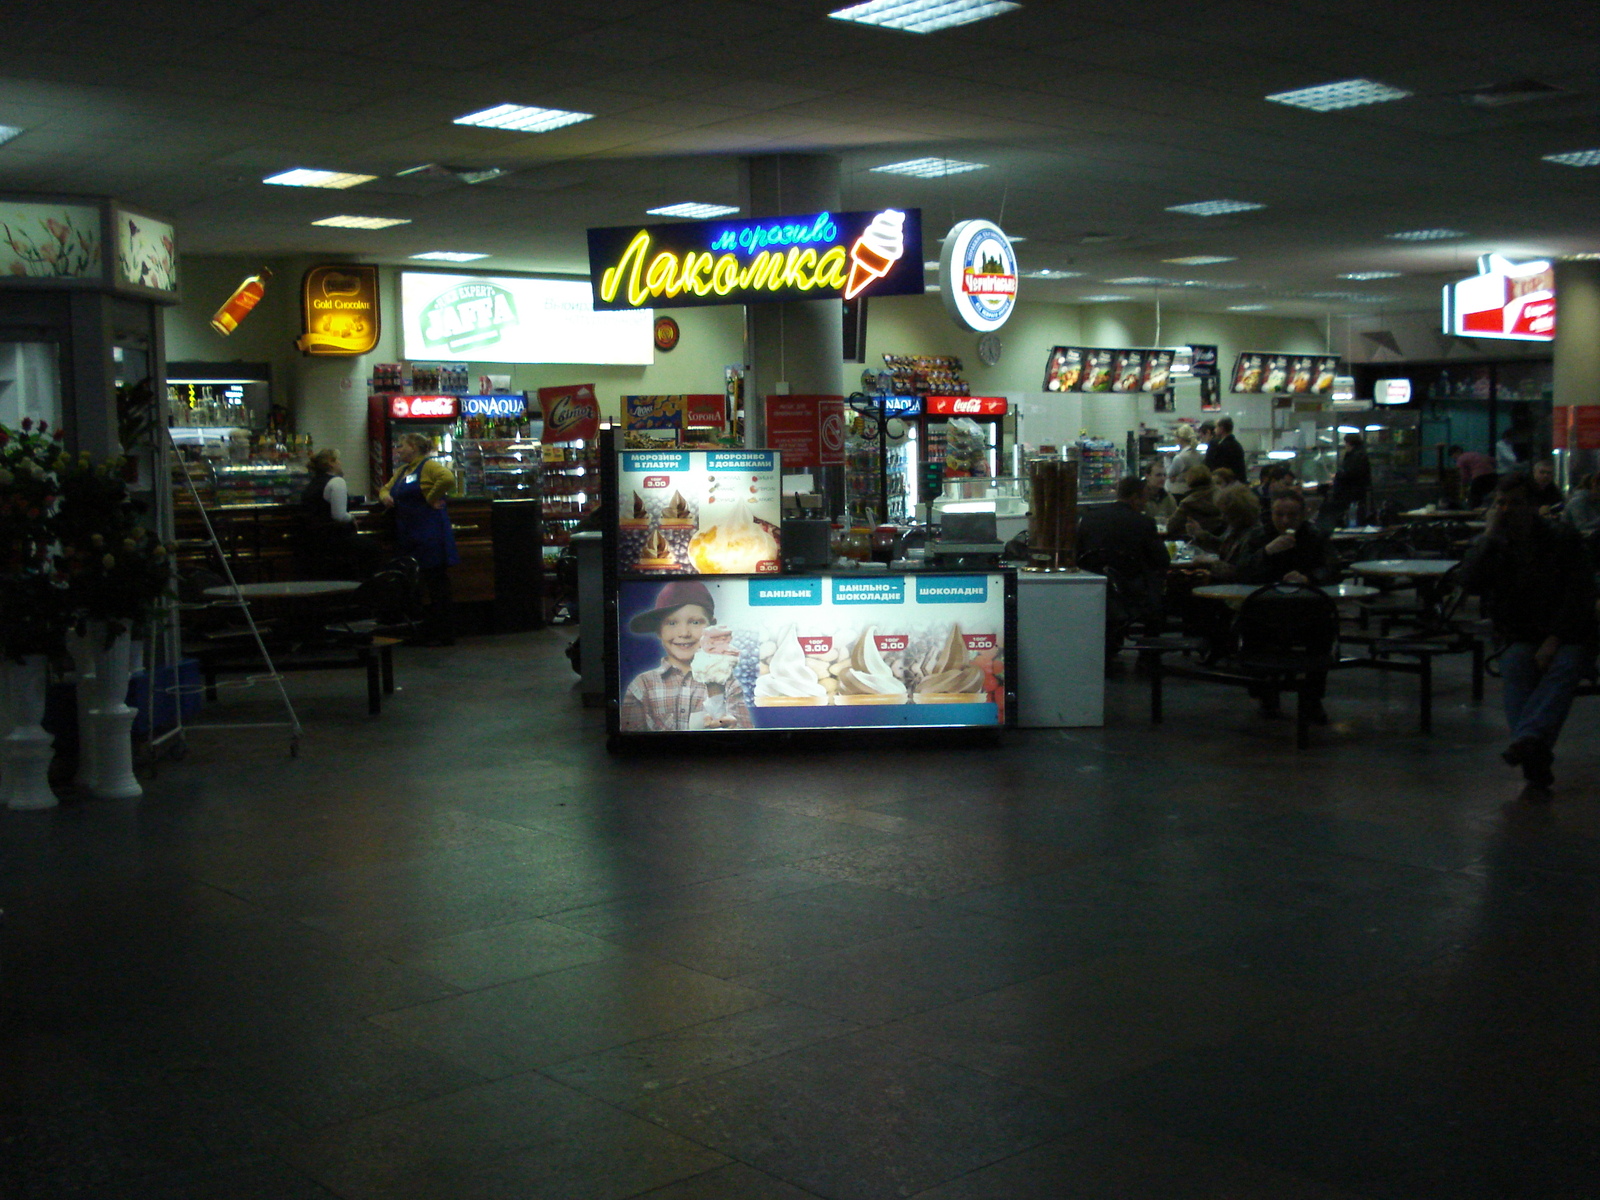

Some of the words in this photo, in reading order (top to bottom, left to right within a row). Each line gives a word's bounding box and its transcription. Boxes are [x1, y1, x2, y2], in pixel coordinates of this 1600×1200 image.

[712, 212, 837, 254] морозиво
[600, 229, 848, 306] Лакомка
[313, 299, 333, 309] Gold
[426, 293, 515, 341] JAFFA
[411, 397, 454, 416] Coca-Cola
[953, 398, 981, 413] Coca-Cola
[641, 461, 679, 469] ГЛАЗУРІ
[715, 461, 772, 469] ДОБАВКАМИ
[759, 590, 812, 598] ВАНІЛЬНЕ
[919, 587, 985, 596] ШОКОЛАДНЕ
[836, 592, 901, 602] ШОКОЛАДНЕ
[805, 644, 829, 652] 3.00
[880, 642, 905, 650] 3.00
[968, 641, 992, 649] 3.00
